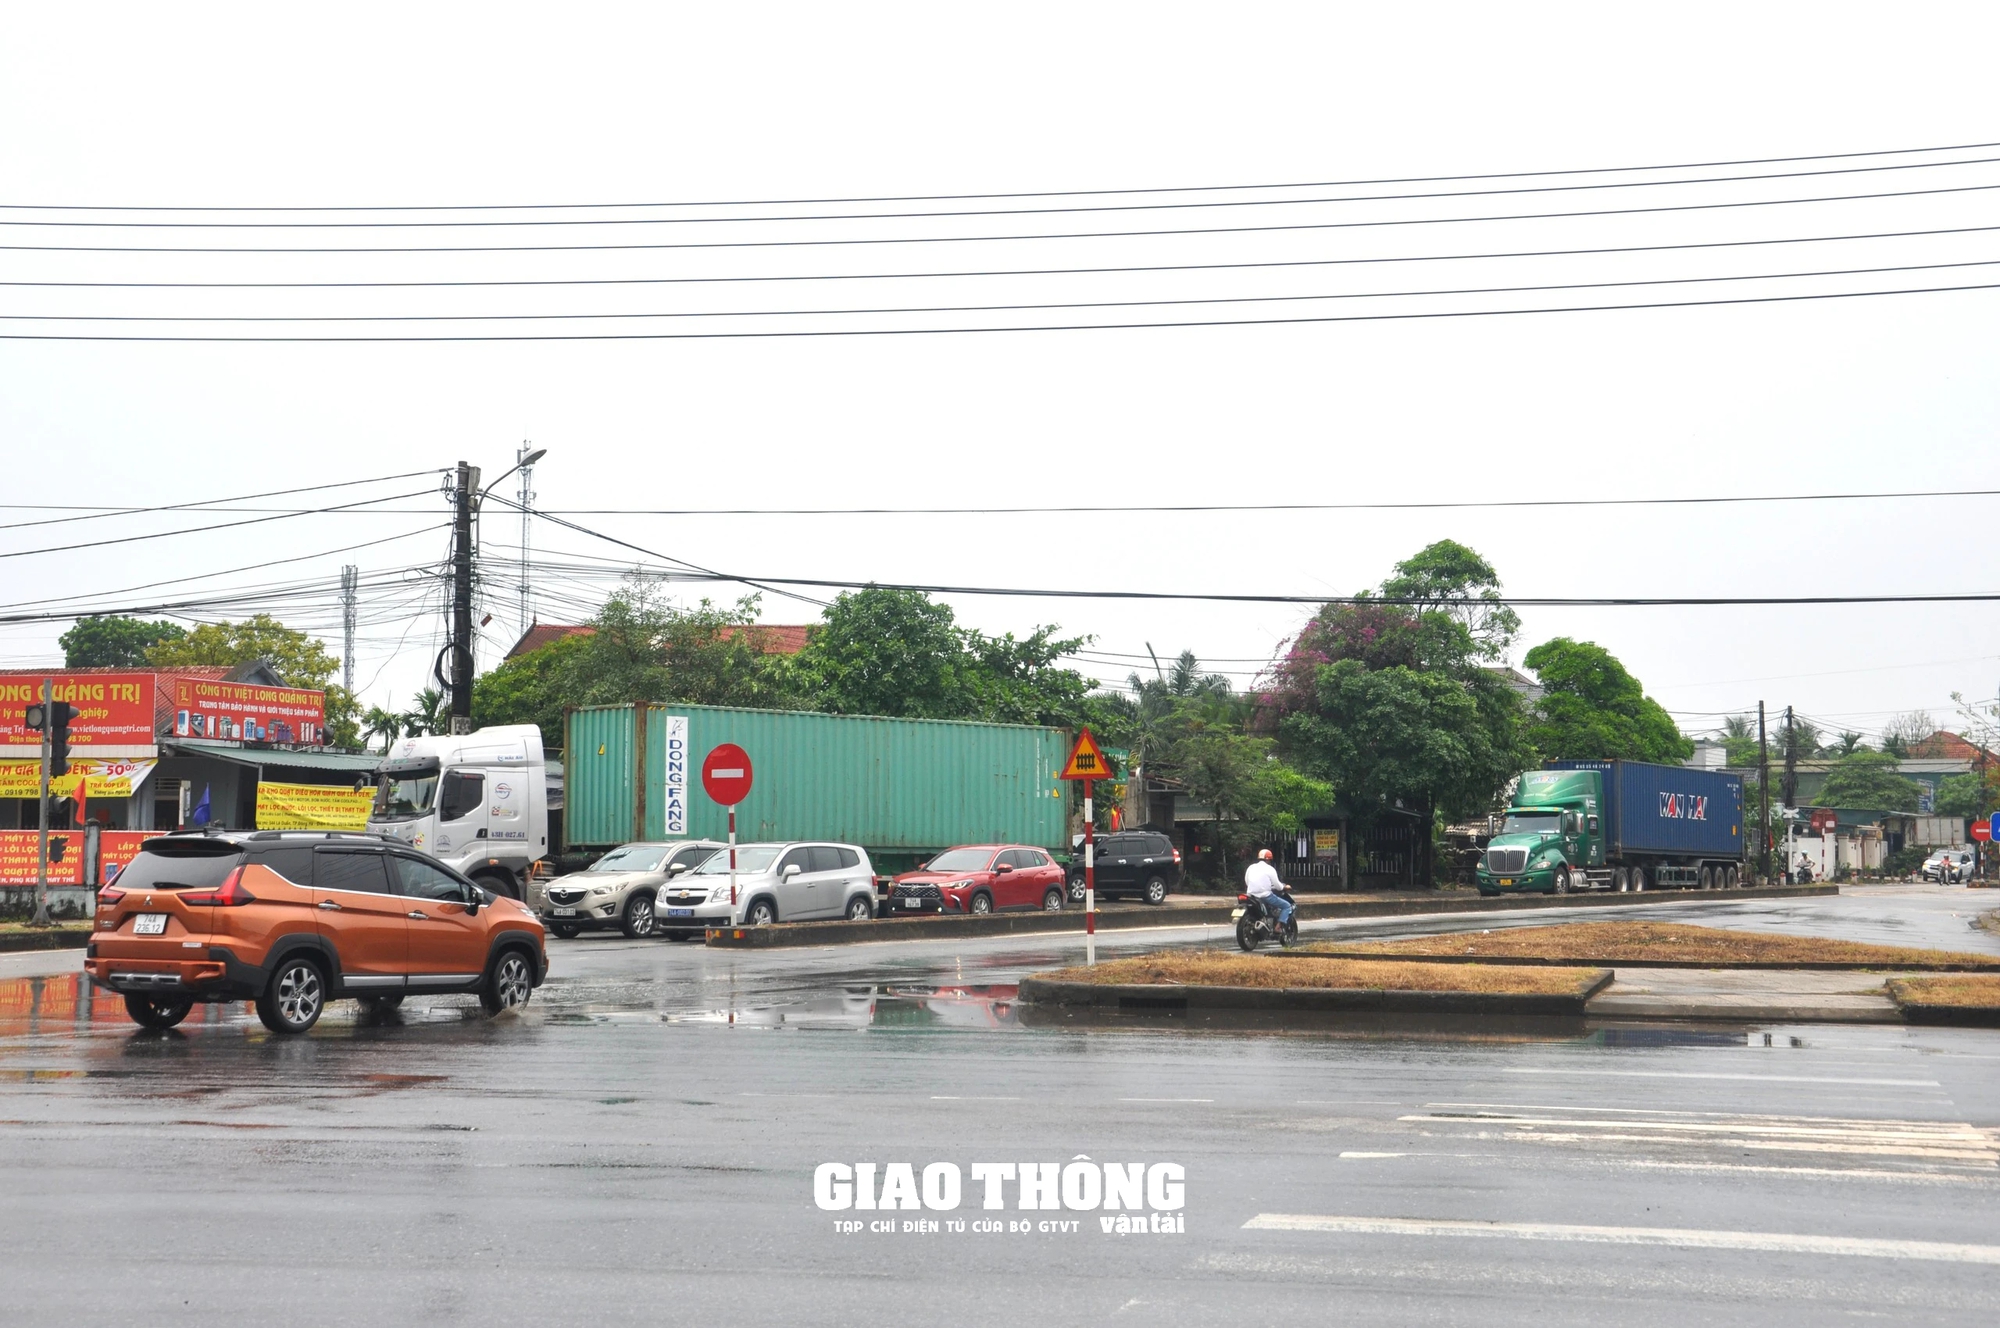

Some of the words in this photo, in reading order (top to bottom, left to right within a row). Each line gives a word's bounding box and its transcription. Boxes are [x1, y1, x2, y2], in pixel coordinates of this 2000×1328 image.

[37, 679, 104, 702] QUẢNG
[109, 683, 141, 705] TRỊ
[195, 683, 220, 697] CÔNG
[221, 688, 232, 699] TY
[234, 687, 253, 701] VIỆT
[255, 690, 276, 702] LONG
[279, 690, 307, 704] QUẢNG
[308, 695, 322, 708] TRỊ
[198, 700, 217, 709] TRUNG
[218, 701, 230, 710] TÂM
[231, 702, 242, 711] BẢO
[243, 703, 258, 713] HÀNH
[278, 706, 293, 716] THIỆU
[13, 725, 24, 734] Trị
[9, 735, 24, 744] Điện
[669, 739, 682, 783] DONG
[15, 764, 35, 775] GIÁ
[668, 787, 682, 832] FANG
[1660, 791, 1684, 819] WAN
[4, 834, 25, 843] MÁY
[26, 835, 39, 843] LỌ
[66, 846, 82, 854] OẠI
[102, 851, 118, 859] MÁY
[3, 856, 28, 864] THAN
[62, 856, 78, 864] ÍNH
[3, 868, 29, 876] QUẠT
[55, 867, 74, 875] HÒA
[144, 914, 157, 923] 74A
[136, 923, 161, 932] 236.12
